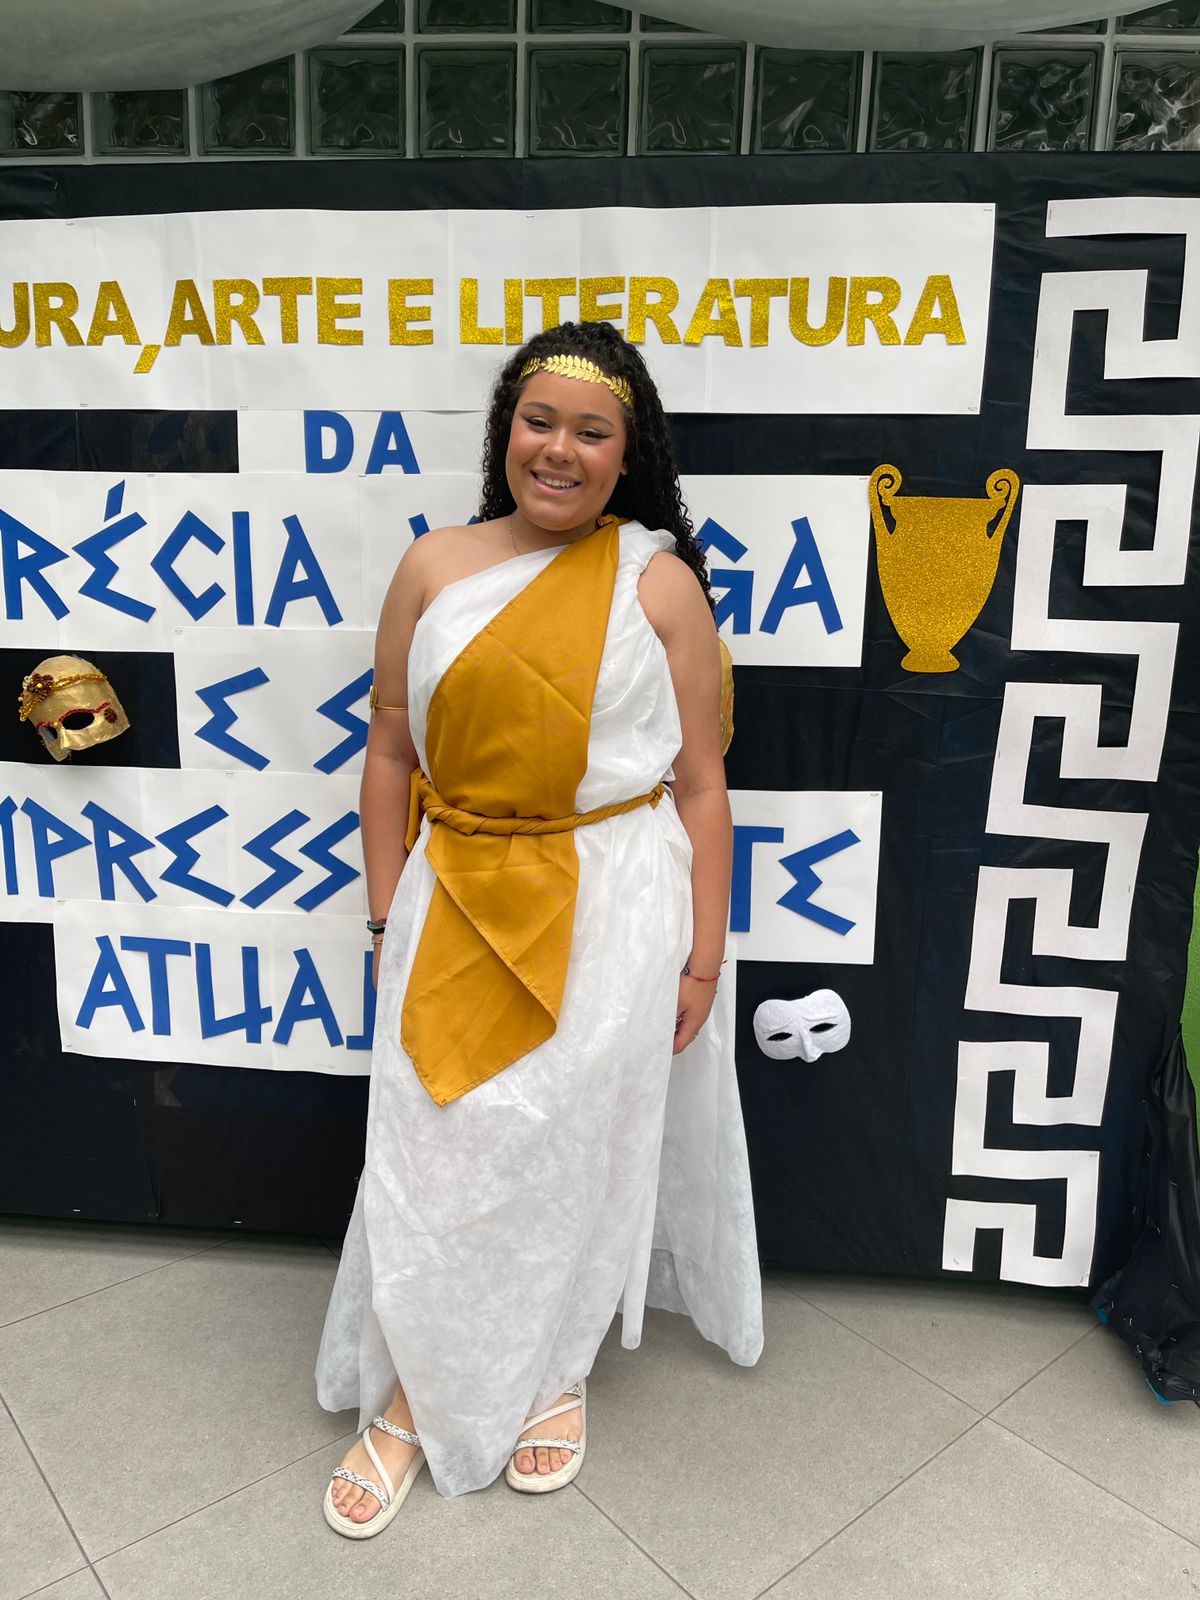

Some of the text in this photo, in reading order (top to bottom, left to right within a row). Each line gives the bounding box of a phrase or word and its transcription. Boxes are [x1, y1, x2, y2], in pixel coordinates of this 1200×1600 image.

[163, 277, 365, 346] ARTE
[388, 278, 434, 345] E
[459, 274, 967, 348] LITERATURA
[304, 411, 421, 475] DA
